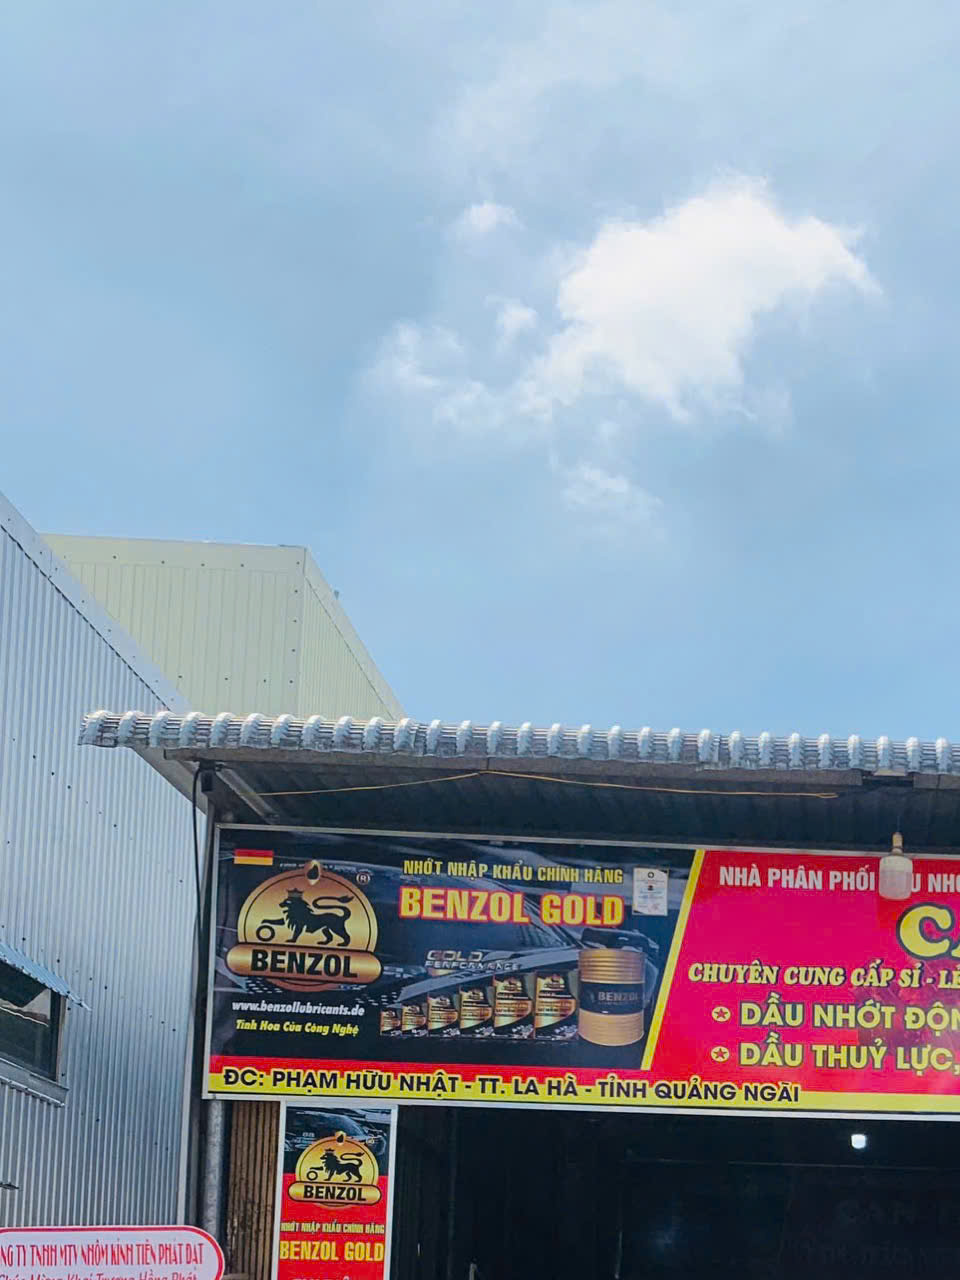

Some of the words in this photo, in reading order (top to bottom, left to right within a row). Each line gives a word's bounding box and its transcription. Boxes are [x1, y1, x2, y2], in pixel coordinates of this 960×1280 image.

[403, 858, 442, 876] NHỚT
[448, 861, 489, 880] NHẬP
[492, 860, 533, 881] KHẨU
[537, 865, 579, 882] CHÍNH
[719, 865, 762, 887] NHÀ
[767, 865, 823, 890] PHÂN
[829, 864, 875, 892] PHỐI
[400, 887, 530, 924] BENZOL
[541, 895, 624, 926] GOLD
[250, 949, 358, 979] BENZOL
[688, 959, 779, 985] CHUYÊN
[784, 966, 845, 986] CUNG
[851, 959, 895, 987] CẤP
[232, 1000, 365, 1016] www.benzollubricants.de
[740, 992, 803, 1027] DẦU
[814, 999, 896, 1029] NHỚT
[259, 1020, 280, 1031] Hoa
[740, 1031, 803, 1067] DẦU
[897, 1044, 960, 1076] LỰC,
[223, 1068, 264, 1087] ĐC:
[272, 1071, 338, 1093] PHẠM
[346, 1069, 391, 1091] HỮU
[399, 1072, 459, 1097] NHẬT
[478, 1077, 505, 1094] TT.
[514, 1079, 539, 1096] LA
[547, 1075, 577, 1097] HÀ
[598, 1072, 647, 1098] TỈNH
[654, 1076, 737, 1101] QUẢNG
[744, 1081, 800, 1102] NGÃI
[304, 1185, 366, 1201] BENZOL
[280, 1241, 339, 1260] BENZOL
[344, 1242, 384, 1261] GOLD
